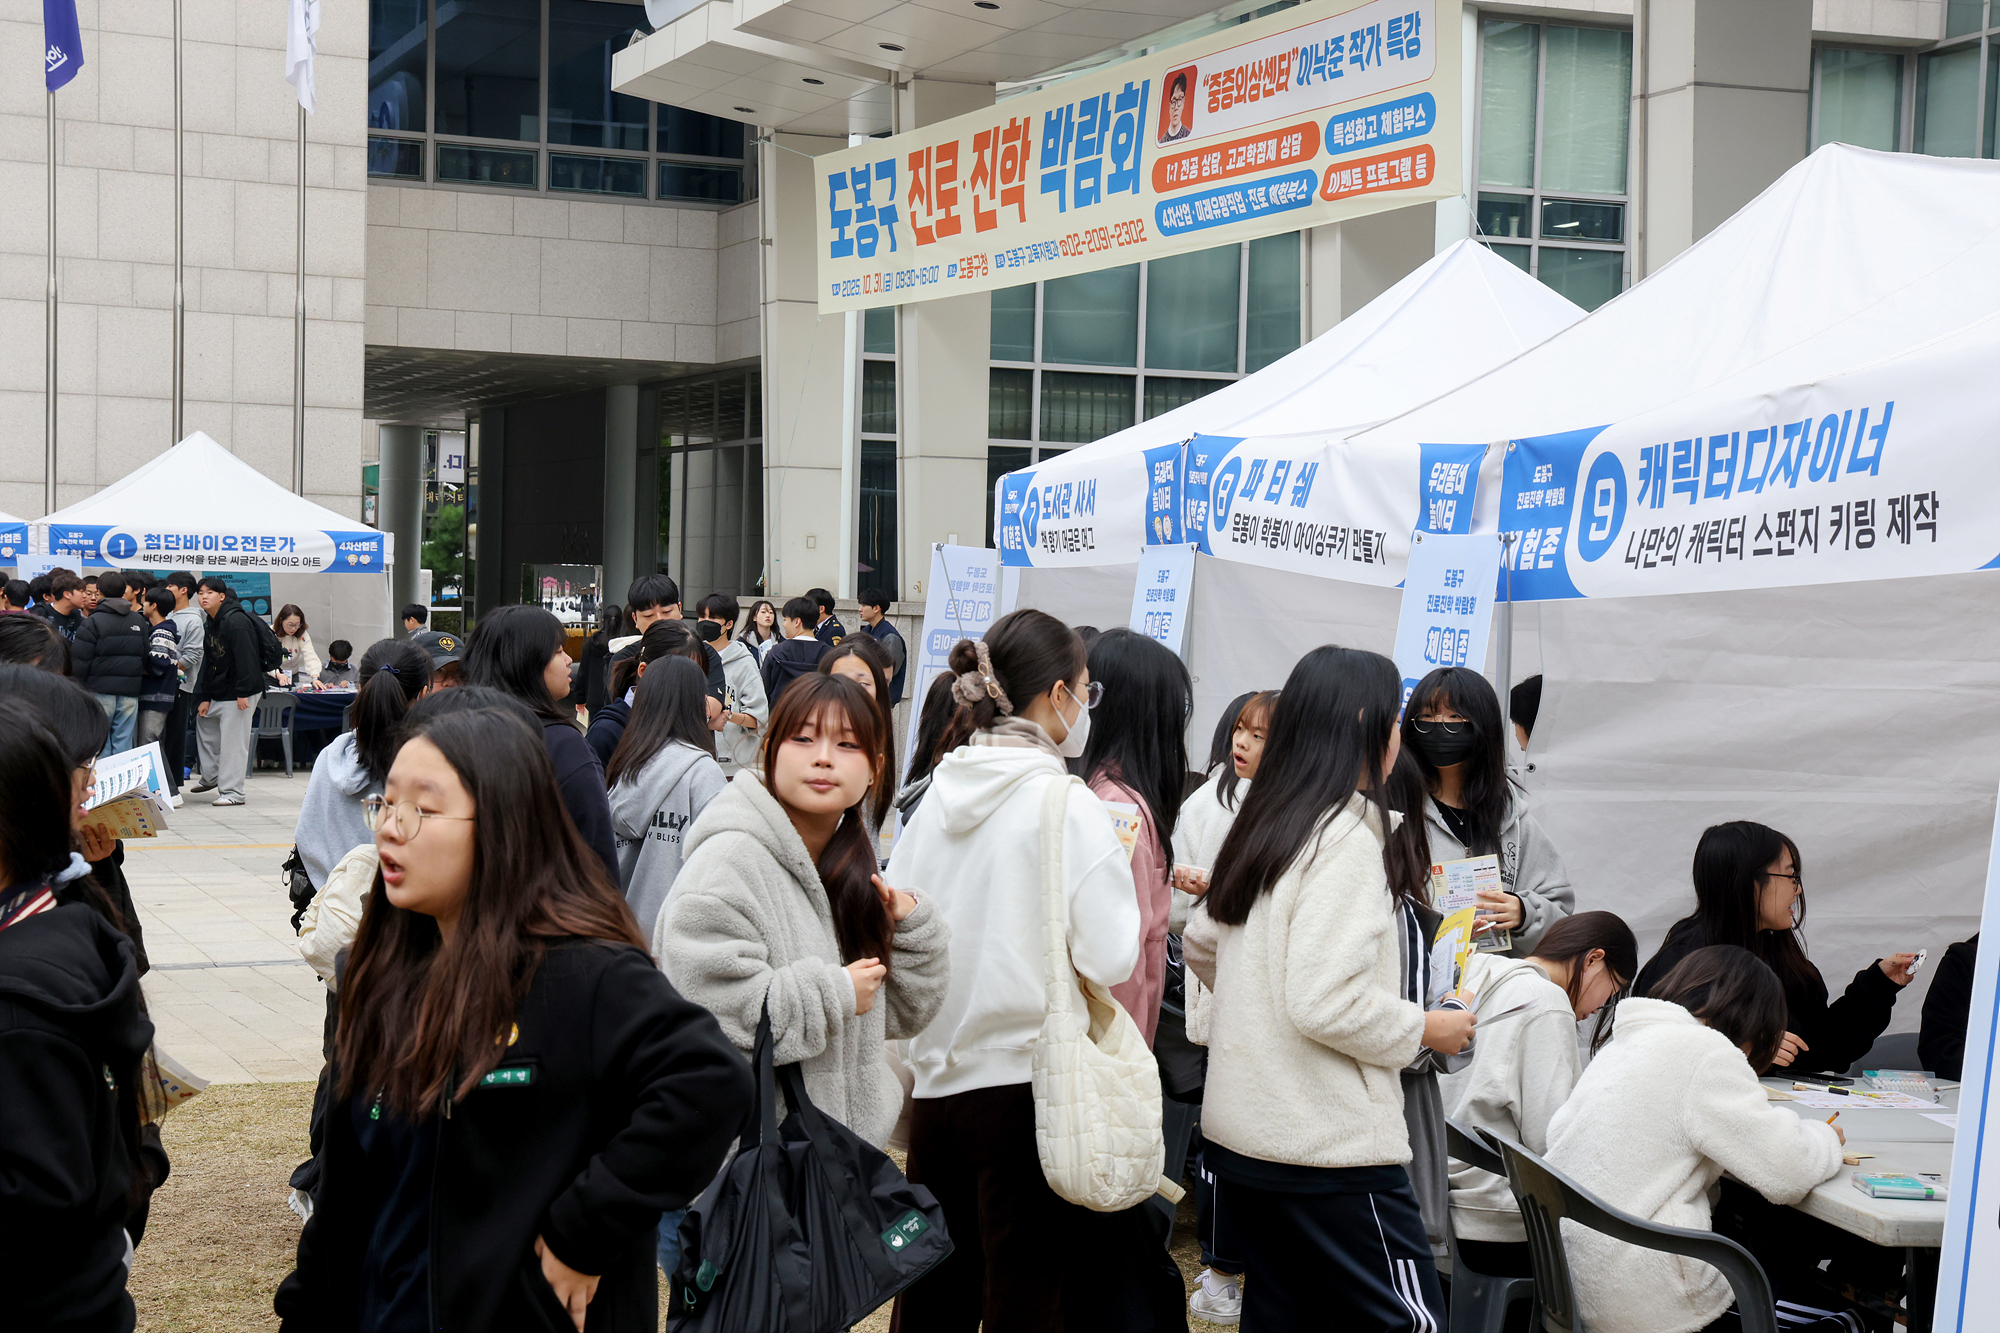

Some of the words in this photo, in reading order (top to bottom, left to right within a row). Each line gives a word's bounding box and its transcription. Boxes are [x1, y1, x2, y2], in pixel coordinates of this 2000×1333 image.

[1349, 23, 1381, 72] 작가
[1387, 10, 1421, 61] 특강
[1333, 114, 1377, 147] 특성화고
[1381, 103, 1427, 136] 체험부스
[828, 158, 899, 259] 도봉구
[1040, 79, 1150, 213] 박람회
[1166, 162, 1178, 183] 1:1
[1180, 157, 1199, 181] 전공
[1201, 152, 1223, 176] 상담,
[1226, 138, 1277, 170] 고교학점제
[1280, 132, 1302, 159] 상담
[1327, 167, 1363, 194] 이벤트
[1366, 156, 1412, 189] 프로그램
[1415, 153, 1427, 180] 등
[1268, 178, 1308, 206] 체험부스
[959, 252, 989, 280] 도봉구청
[1006, 246, 1026, 268] 도봉구
[1026, 239, 1060, 264] 교육지원과
[895, 265, 940, 289] 09:30~16:00
[1637, 401, 1895, 509] 캐릭터디자이너
[1428, 462, 1470, 495] 우리동네
[1533, 464, 1553, 483] 도봉구
[1042, 482, 1072, 519] 도서관
[1074, 478, 1096, 517] 사서
[1217, 473, 1234, 517] 8
[1516, 489, 1544, 510] 진로진학
[1545, 487, 1565, 507] 박람회
[1589, 477, 1616, 541] 9
[1029, 502, 1036, 536] 7
[1429, 498, 1457, 531] 놀이터
[1625, 524, 1685, 569] 나만의
[1685, 515, 1746, 564] 캐릭터
[1753, 505, 1819, 556] 스펀지
[1829, 498, 1876, 551] 키링
[1886, 490, 1939, 545] 제작
[119, 540, 124, 555] 1
[144, 533, 296, 553] 첨단바이오전문가
[339, 541, 378, 552] 4차산업존
[1232, 512, 1260, 545] 은봉이
[1261, 516, 1293, 551] 학봉이
[1294, 522, 1349, 560] 아이싱쿠키
[1353, 528, 1386, 565] 만들기
[143, 554, 172, 563] 바다의
[176, 554, 204, 565] 기억을
[208, 555, 227, 565] 담은
[230, 556, 268, 566] 씨글라스
[271, 556, 299, 567] 바이오
[303, 557, 321, 567] 아트
[1444, 569, 1465, 588] 도봉구
[1427, 594, 1454, 614] 진로진학
[1454, 596, 1477, 615] 박람회
[1425, 628, 1469, 665] 체험존
[657, 833, 680, 843] BLISS
